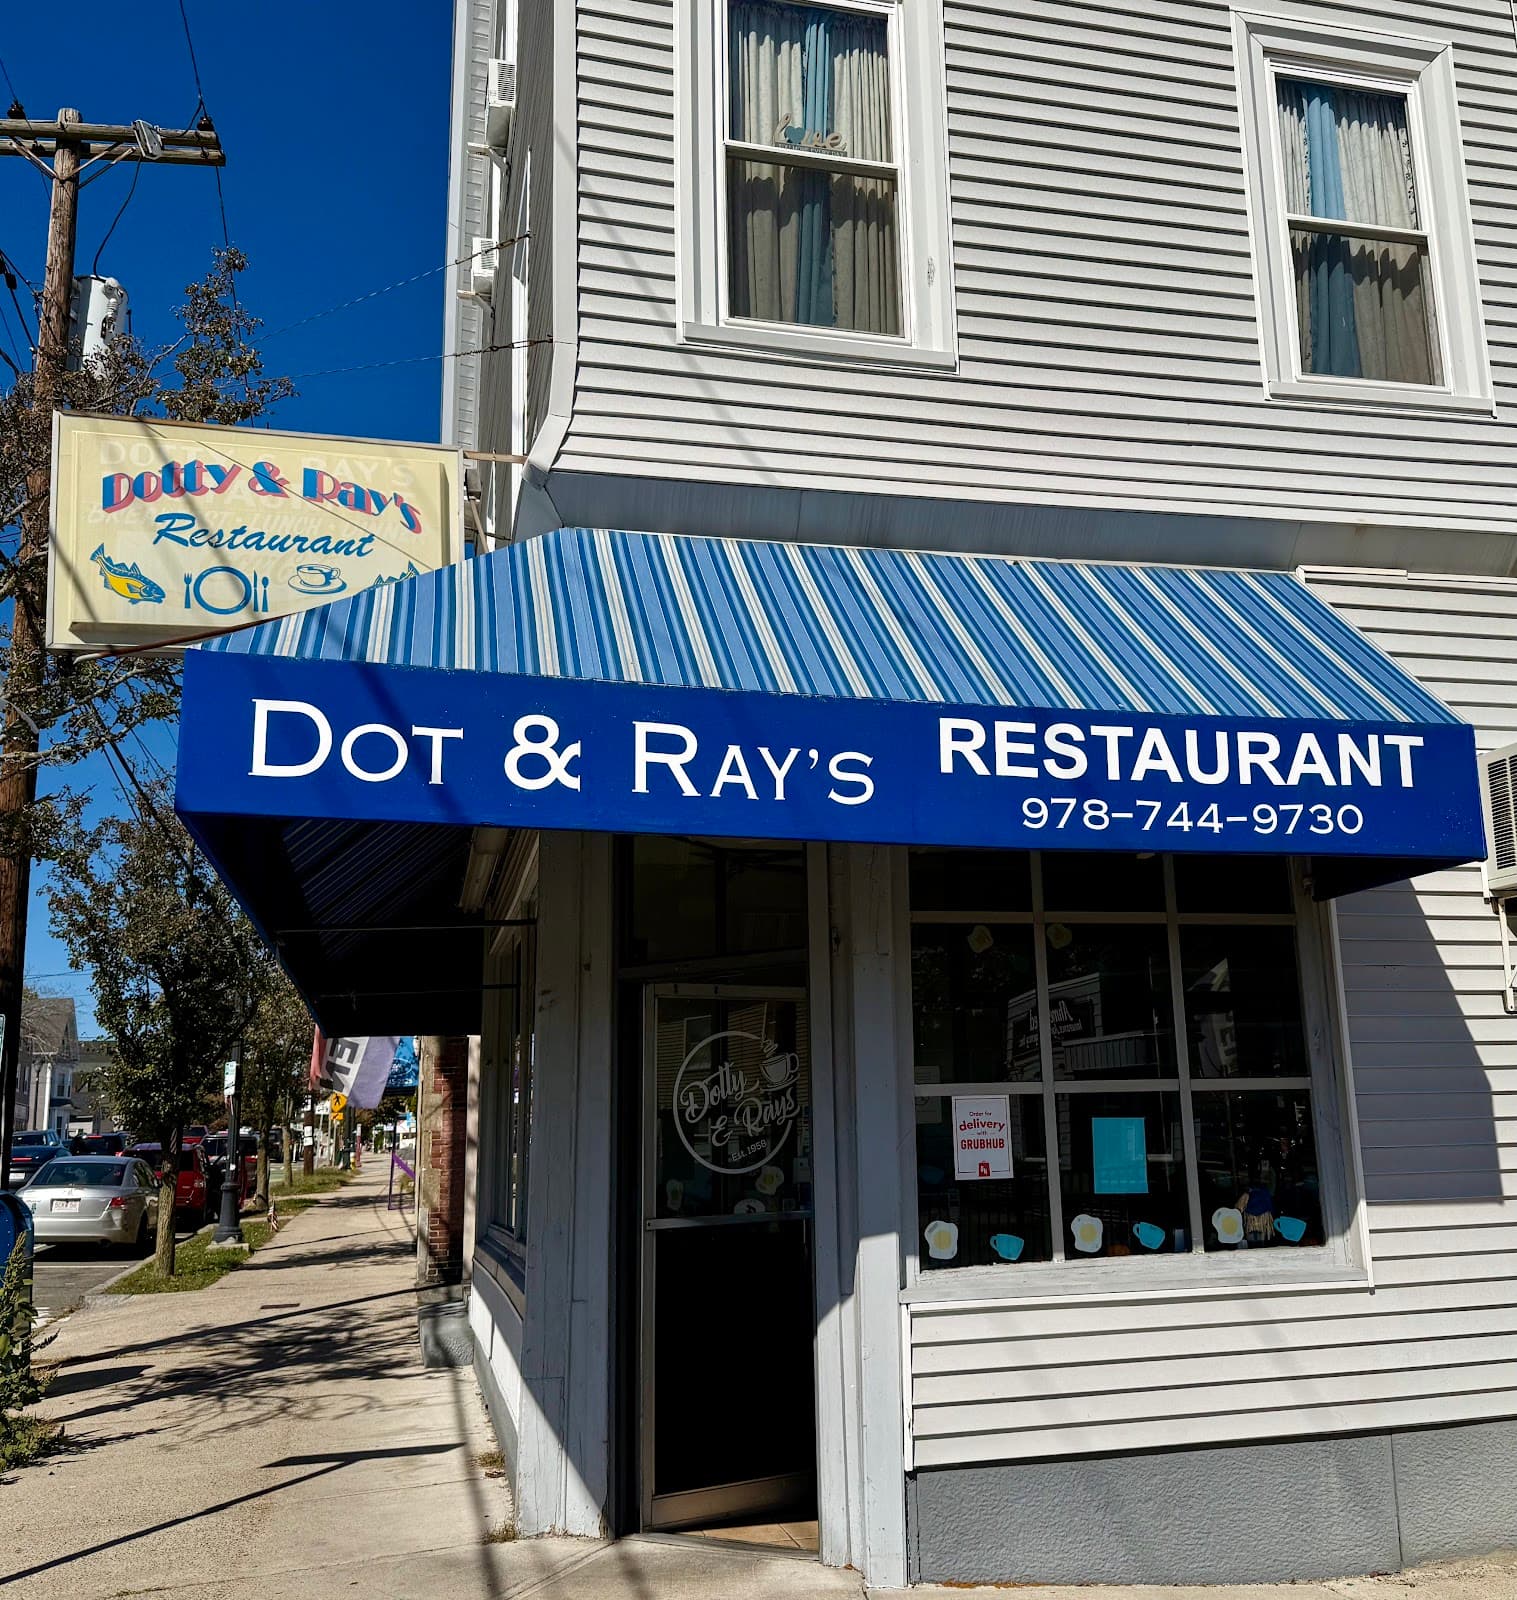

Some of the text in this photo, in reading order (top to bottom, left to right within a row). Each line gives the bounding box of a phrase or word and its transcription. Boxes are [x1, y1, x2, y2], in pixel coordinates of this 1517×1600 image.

[101, 459, 242, 514] Dotty
[247, 461, 291, 499] &
[302, 466, 423, 535] Ray's
[152, 512, 376, 559] Restaurant
[503, 714, 582, 792] &
[938, 716, 1425, 789] RESTAURANT
[1021, 796, 1365, 835] 978-744-9730
[679, 1061, 760, 1124] Dotty
[747, 1138, 768, 1155] 1958
[959, 1118, 1006, 1132] delivery
[960, 1138, 1005, 1150] GRUBHUB
